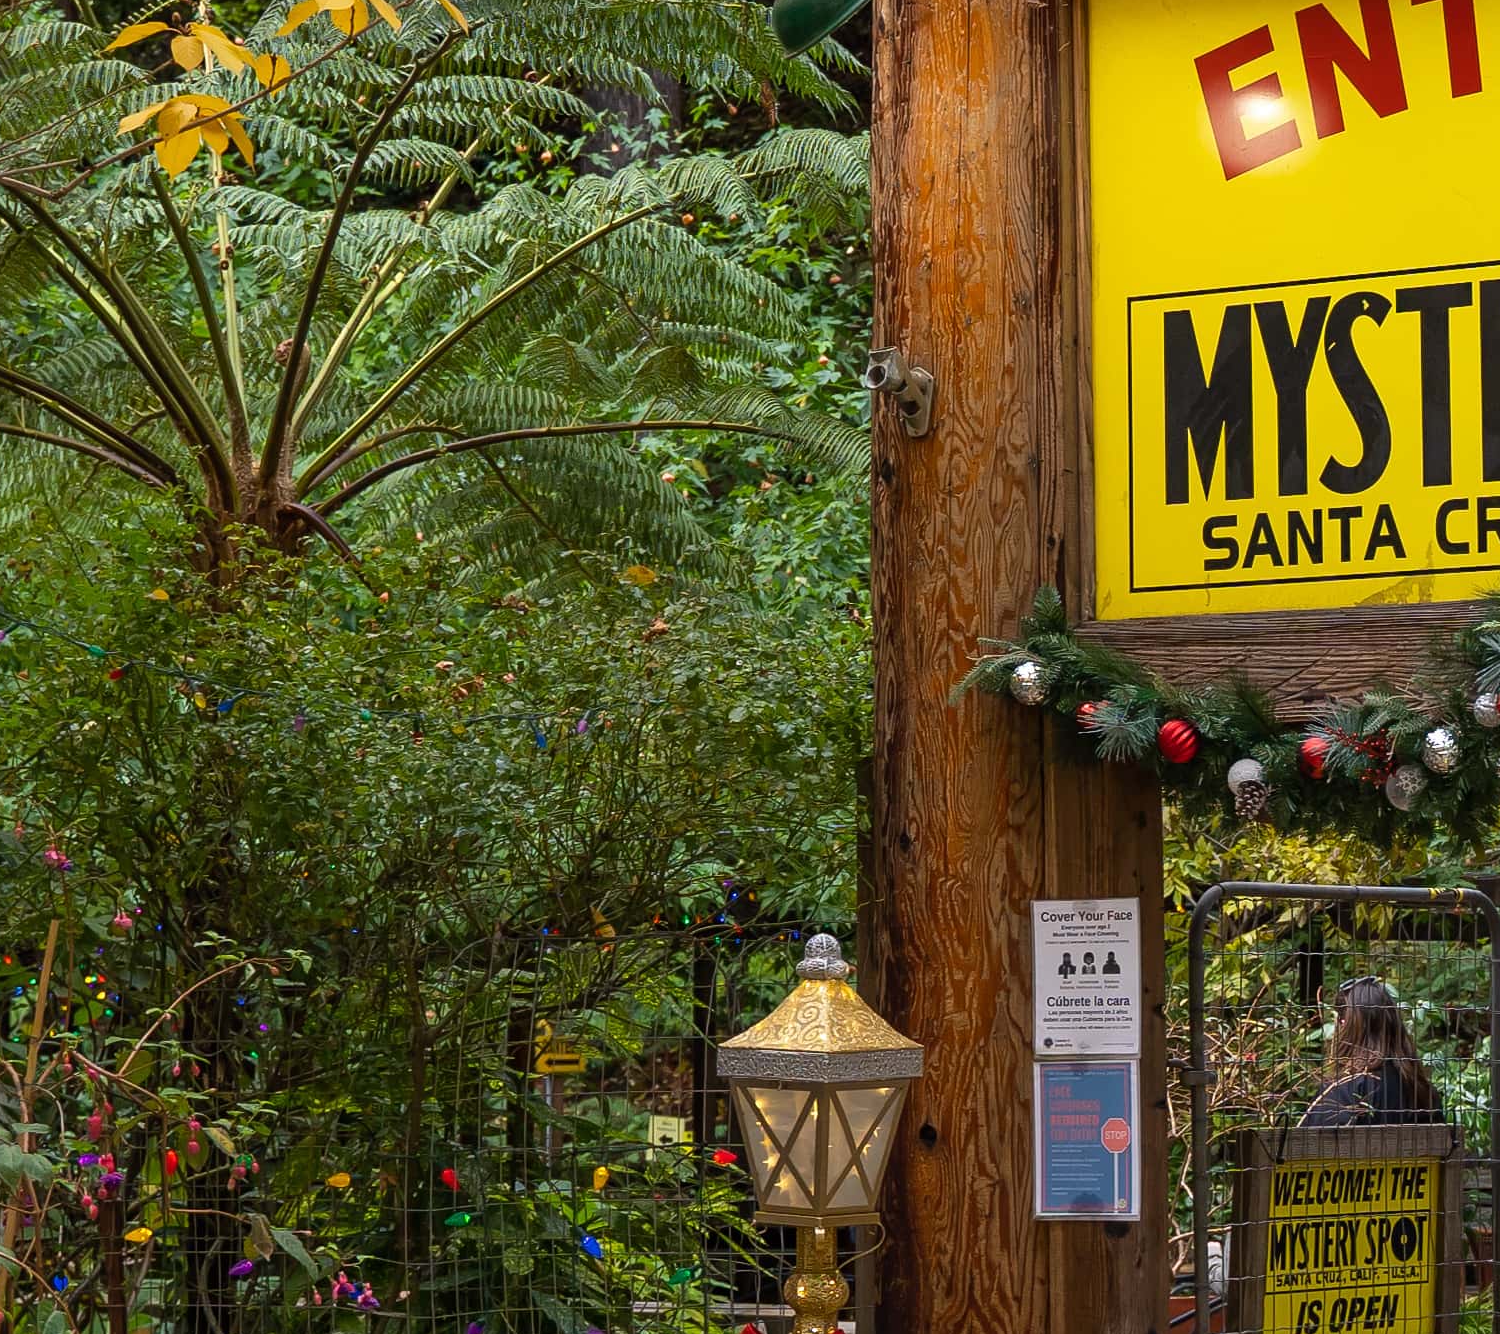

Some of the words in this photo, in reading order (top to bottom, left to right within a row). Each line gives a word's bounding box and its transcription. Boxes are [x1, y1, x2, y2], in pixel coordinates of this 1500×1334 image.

[1203, 504, 1404, 571] SANTA
[1041, 911, 1075, 923] Cover
[1078, 910, 1105, 922] Your
[1107, 910, 1133, 921] Face
[1046, 995, 1092, 1007] Cúbrete
[1094, 996, 1104, 1006] la
[1106, 997, 1130, 1006] cara
[1104, 1130, 1128, 1140] STOP
[1275, 1167, 1384, 1206] WELCOME!
[1391, 1167, 1429, 1200] THE
[1270, 1219, 1360, 1272] MYSTERY
[1364, 1216, 1427, 1264] SPOT
[1276, 1274, 1312, 1287] SANTA
[1329, 1294, 1399, 1333] OPEN
